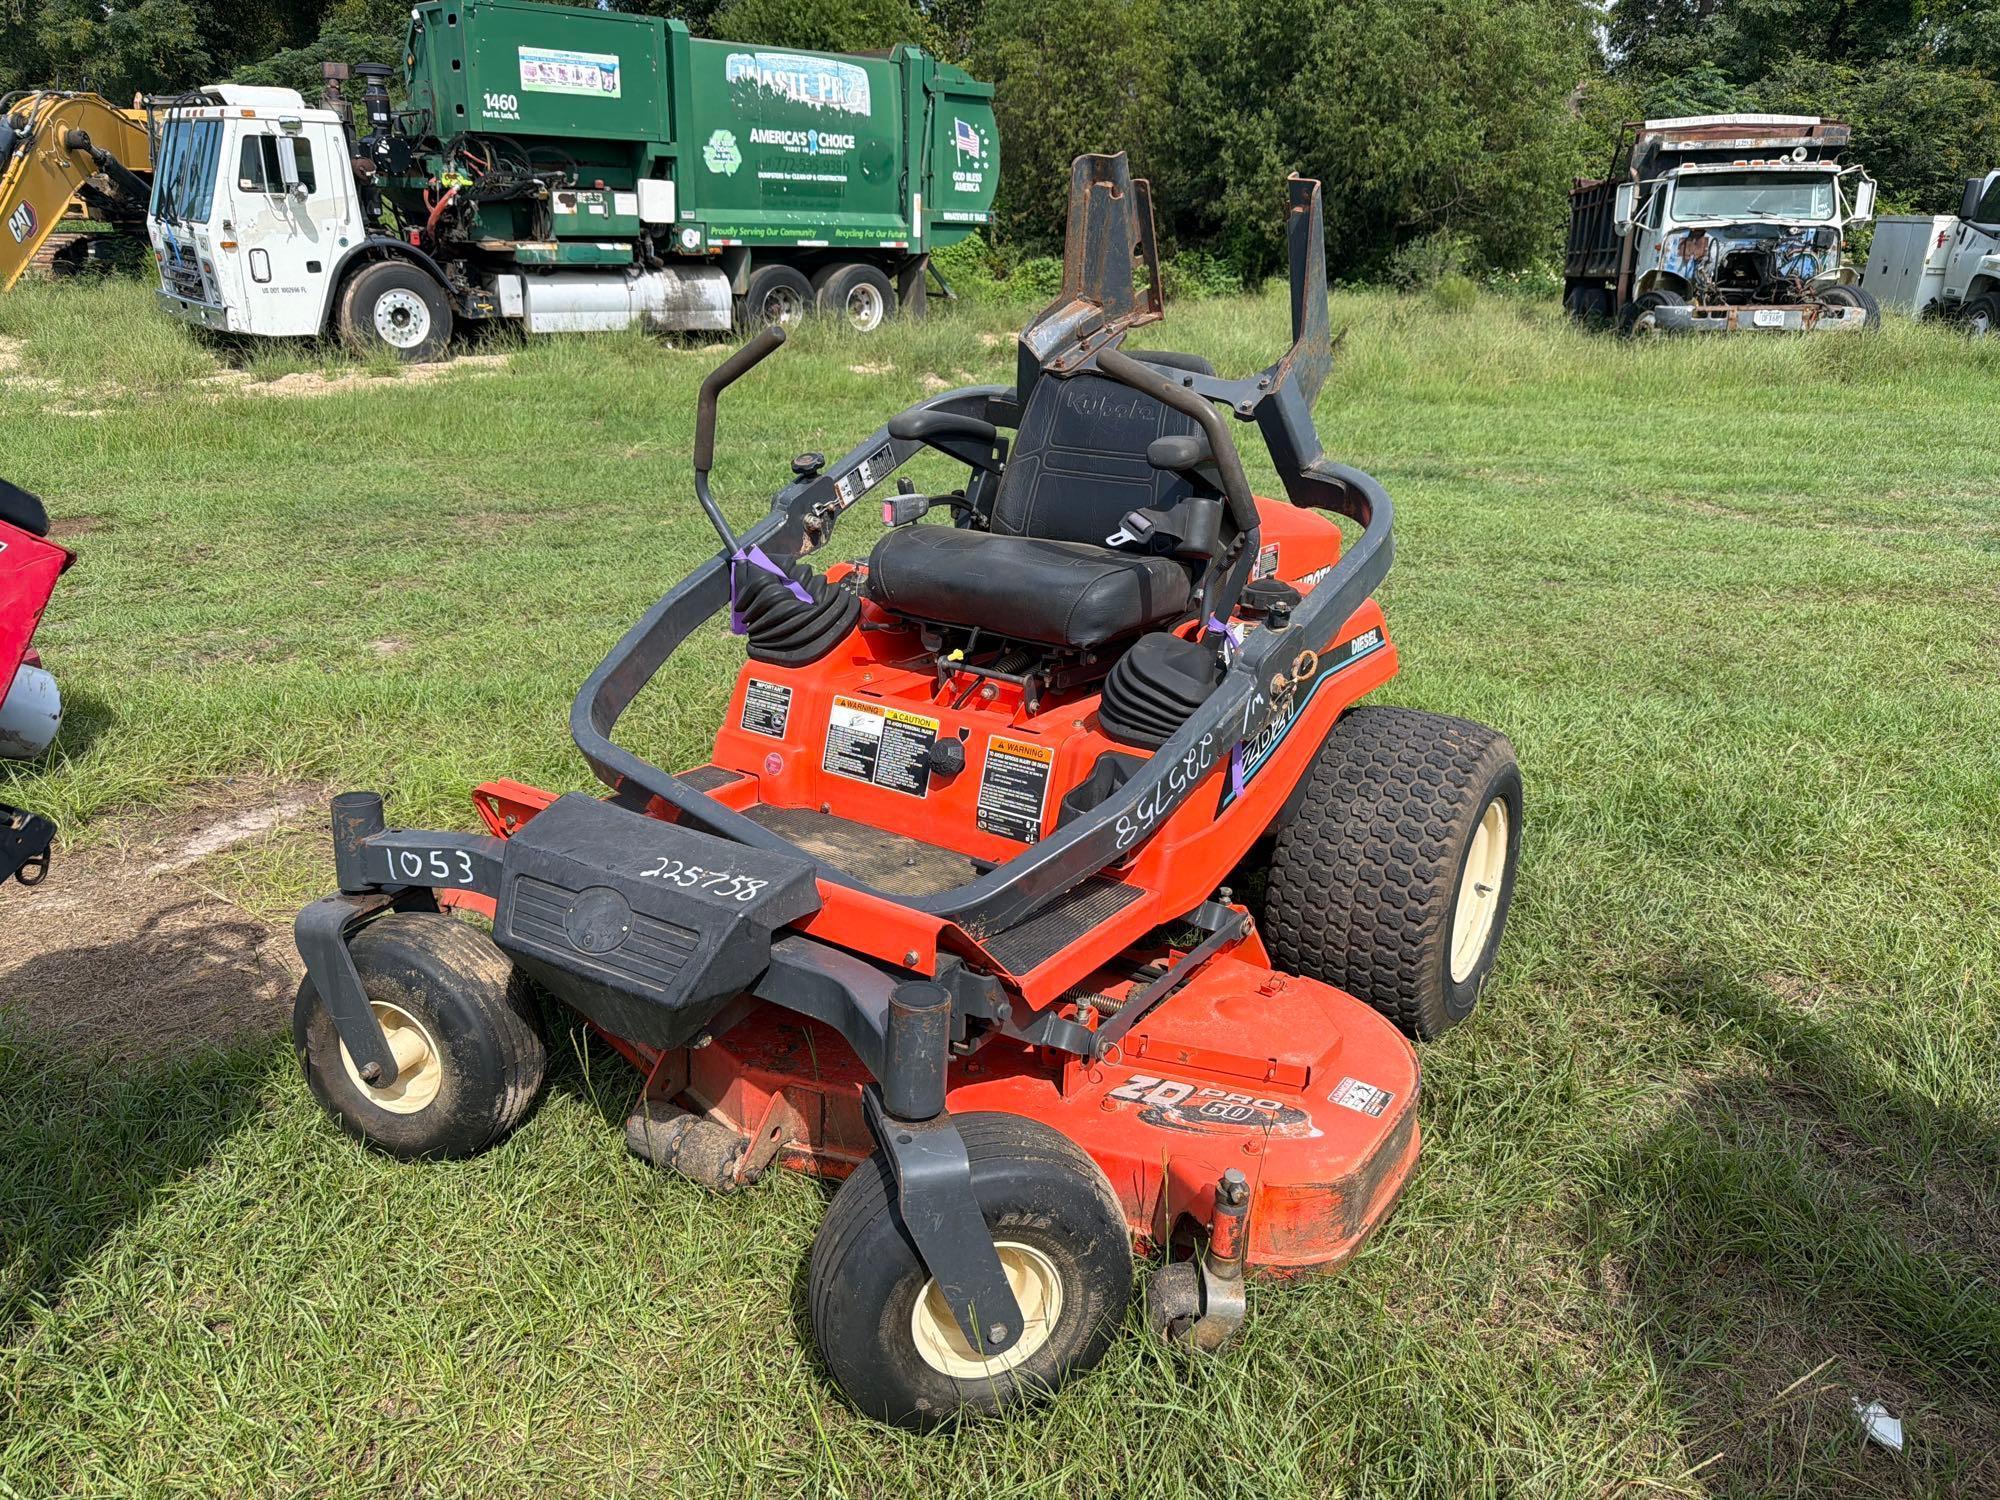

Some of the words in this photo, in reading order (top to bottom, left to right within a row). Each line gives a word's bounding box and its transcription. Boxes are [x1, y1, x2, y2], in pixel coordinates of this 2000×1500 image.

[483, 92, 518, 111] 1460
[750, 127, 807, 145] AMERICA'S
[818, 132, 855, 149] CHOICE
[952, 171, 965, 181] GOD
[966, 172, 982, 183] BLESS
[954, 182, 980, 192] AMERICA
[8, 202, 32, 243] CAT
[710, 226, 738, 237] Proudly
[739, 227, 765, 238] Serving
[766, 228, 779, 237] Our
[780, 228, 816, 239] Community
[835, 229, 863, 239] Recycling
[864, 230, 874, 238] For
[876, 230, 887, 238] Our
[887, 231, 907, 239] Future
[1066, 391, 1155, 421] Kubota
[1351, 629, 1378, 655] DIESEL
[756, 682, 785, 693] IMPORTANT
[845, 699, 879, 715] WARNING
[899, 713, 931, 727] CAUTION
[1007, 742, 1044, 758] WARNING
[1115, 732, 1213, 849] 225758
[386, 848, 474, 883] 1053
[640, 857, 768, 901] 225758
[1108, 1074, 1197, 1103] ZD
[1198, 1088, 1285, 1110] PRO
[1199, 1102, 1254, 1121] 60
